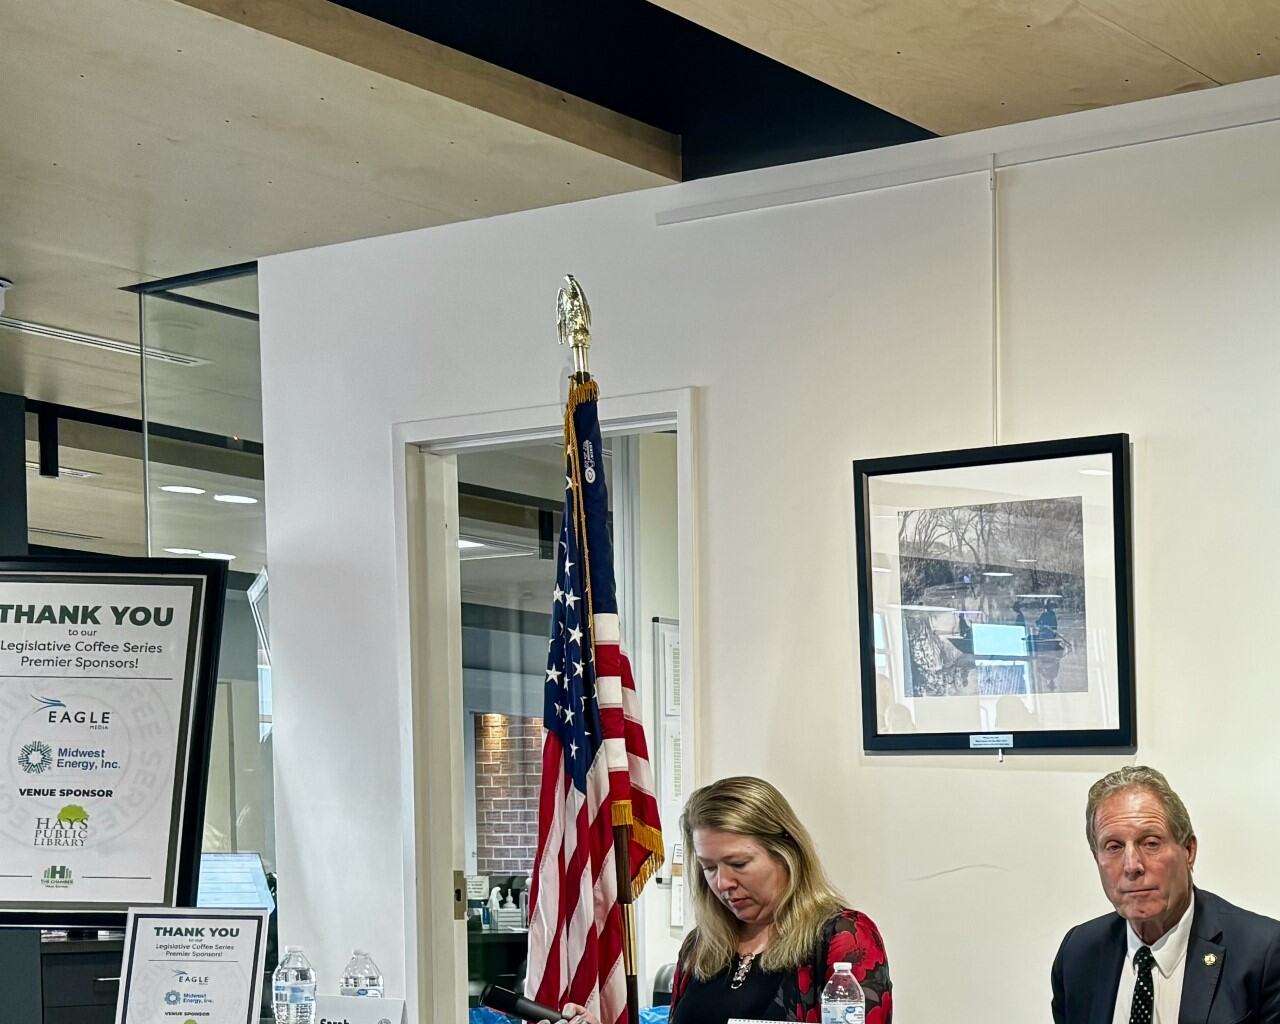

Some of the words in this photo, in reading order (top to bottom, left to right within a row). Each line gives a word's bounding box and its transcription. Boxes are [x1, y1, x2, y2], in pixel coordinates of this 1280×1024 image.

[0, 604, 101, 625] THANK
[110, 605, 174, 627] YOU
[0, 640, 71, 653] Legislative
[75, 641, 119, 653] Coffee
[123, 643, 163, 653] Series
[20, 656, 72, 667] Premier
[75, 657, 139, 670] Sponsors!
[48, 711, 110, 723] EAGLE
[57, 747, 105, 758] Midwest
[56, 759, 98, 770] Energy,
[101, 759, 121, 769] Inc.
[19, 788, 56, 797] VENUE
[59, 789, 113, 797] SPONSOR
[36, 817, 89, 830] HAYS
[35, 829, 88, 839] PUBLIC
[33, 838, 86, 847] LIBRARY
[154, 927, 205, 937] THANK
[209, 927, 240, 938] YOU
[155, 943, 190, 951] Legislative
[192, 950, 223, 958] Sponsors!
